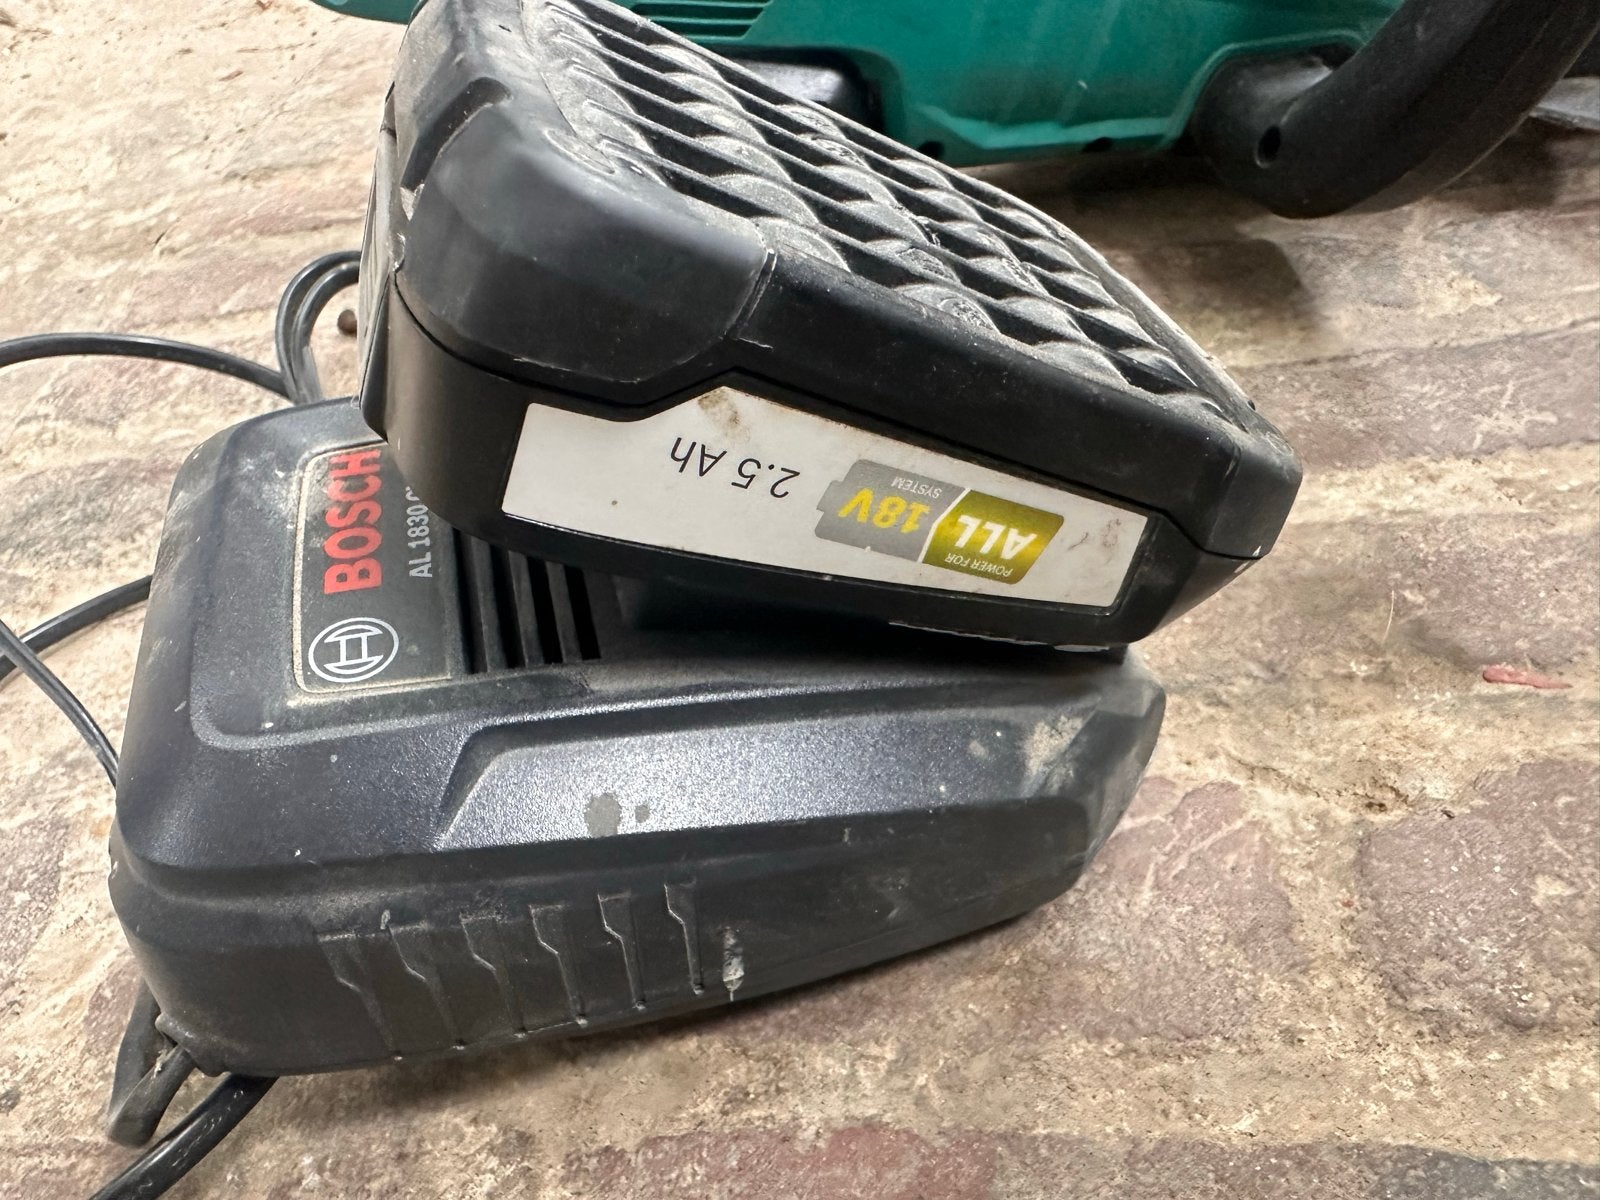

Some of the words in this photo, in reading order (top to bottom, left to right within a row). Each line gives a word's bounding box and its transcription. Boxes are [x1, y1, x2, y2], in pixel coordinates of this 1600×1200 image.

[669, 437, 727, 478] Ah
[730, 458, 801, 499] 2.5
[891, 476, 943, 499] SYSTEM
[324, 448, 382, 595] BOSCH
[407, 504, 431, 549] 1830
[838, 487, 930, 534] 18V
[953, 514, 1038, 560] ALL
[409, 552, 433, 578] AL
[944, 552, 970, 568] FOR
[972, 559, 1014, 578] POWER
